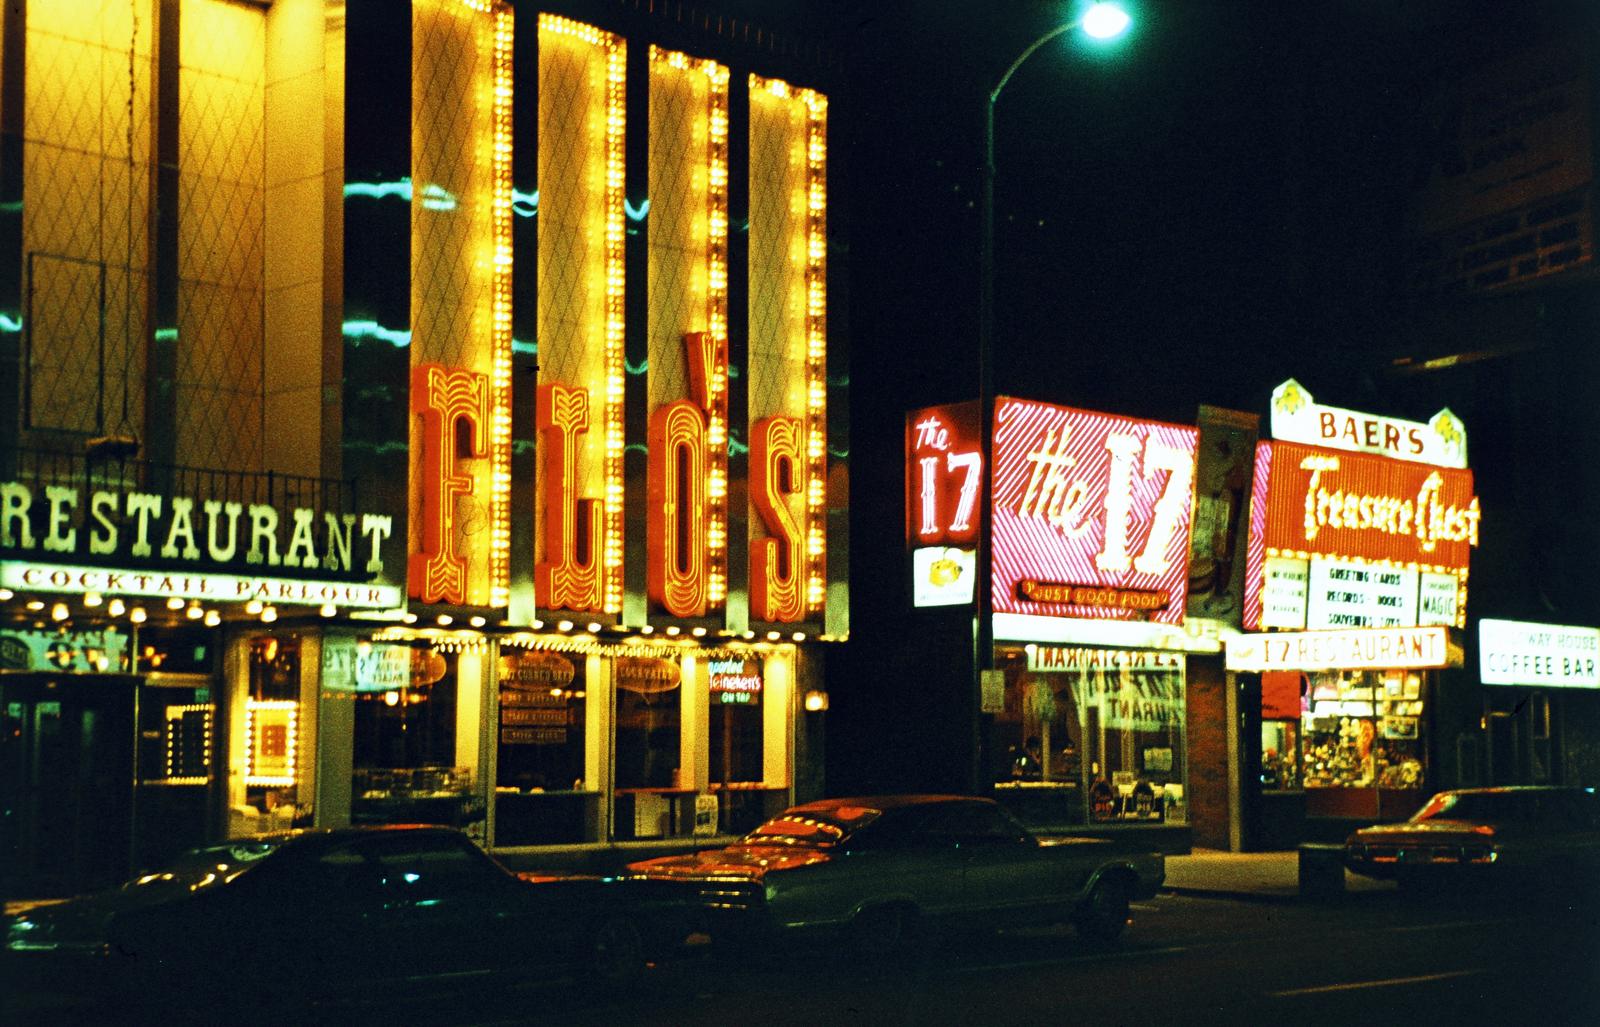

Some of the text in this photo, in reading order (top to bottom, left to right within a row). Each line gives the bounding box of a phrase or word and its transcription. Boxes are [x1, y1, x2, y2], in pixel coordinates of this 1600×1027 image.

[916, 417, 950, 450] the
[1319, 411, 1425, 454] BAER'S
[919, 451, 981, 534] 17
[1018, 424, 1092, 539] the
[1096, 432, 1194, 577] 17
[1300, 455, 1481, 552] Treasure Chest
[0, 482, 392, 572] RESTAURANT
[22, 568, 382, 604] COCKTAIL PARLOUR
[1297, 632, 1438, 662] RESTAURANT
[1488, 652, 1595, 677] COFFEE BAR
